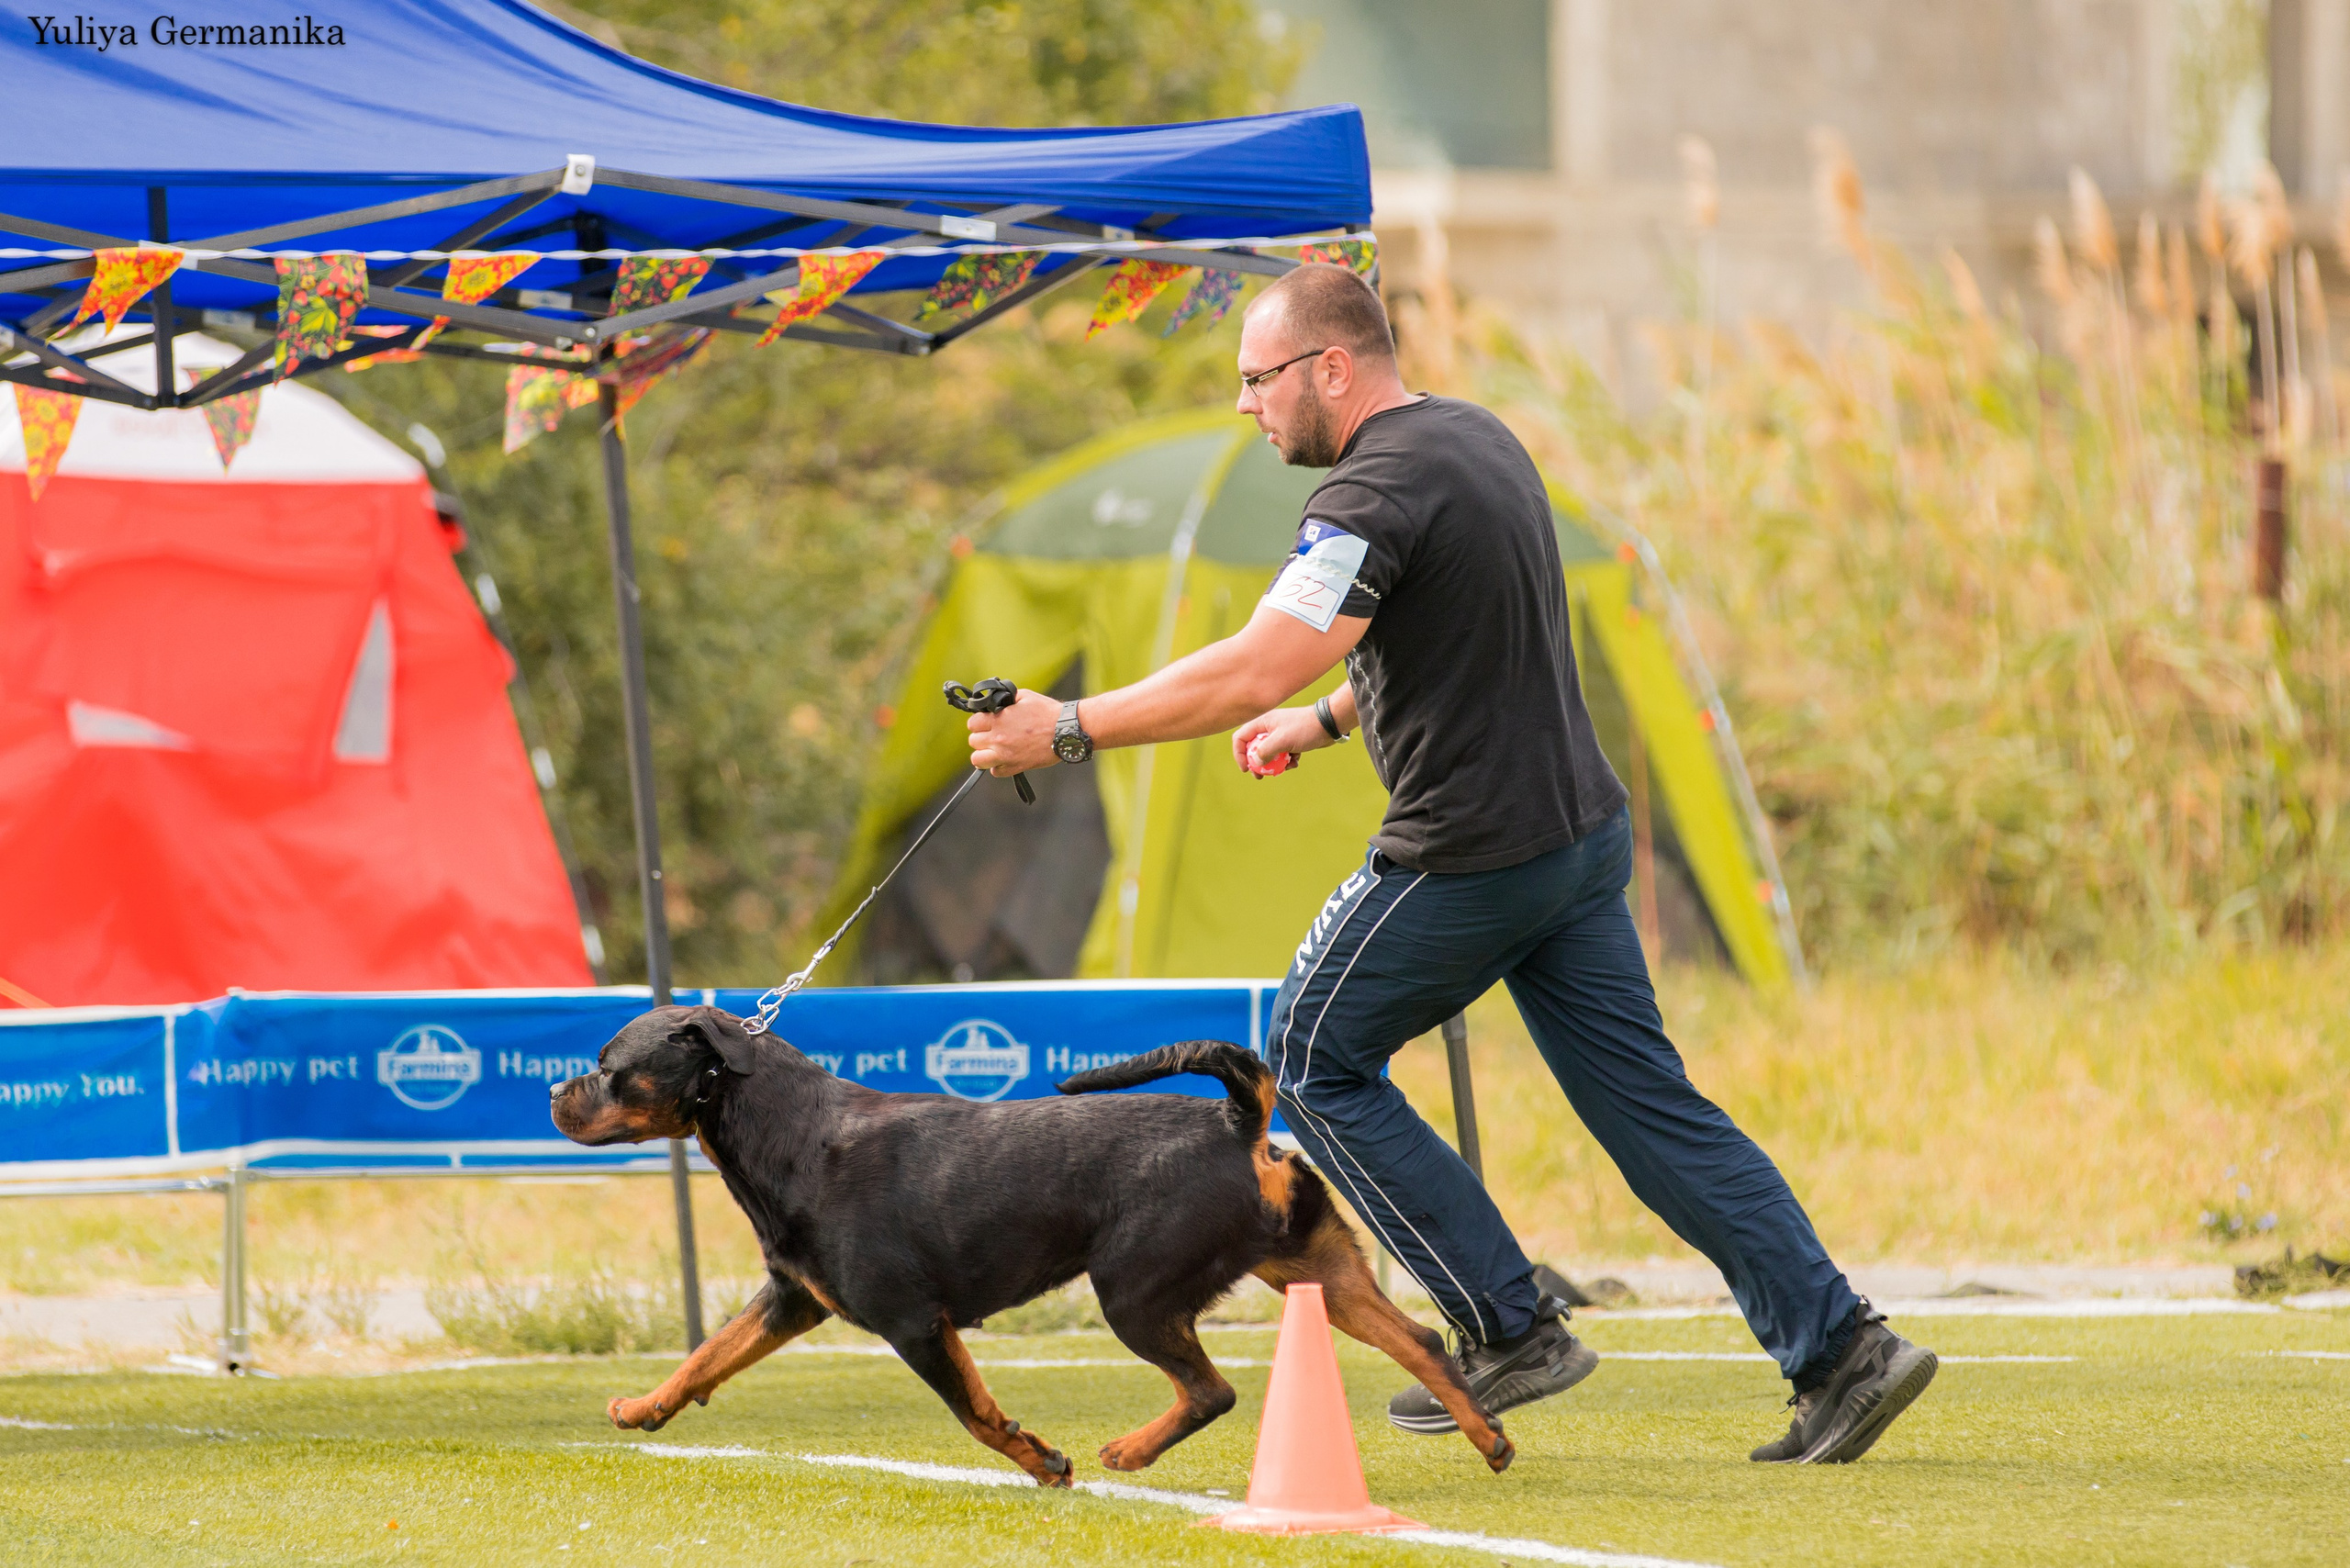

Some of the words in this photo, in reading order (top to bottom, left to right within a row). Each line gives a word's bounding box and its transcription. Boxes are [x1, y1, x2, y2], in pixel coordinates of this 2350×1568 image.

[197, 1058, 296, 1085] Happy
[308, 1056, 359, 1084] pet
[856, 1047, 907, 1079] pet
[1046, 1046, 1138, 1072] Hap
[0, 1082, 70, 1108] appy
